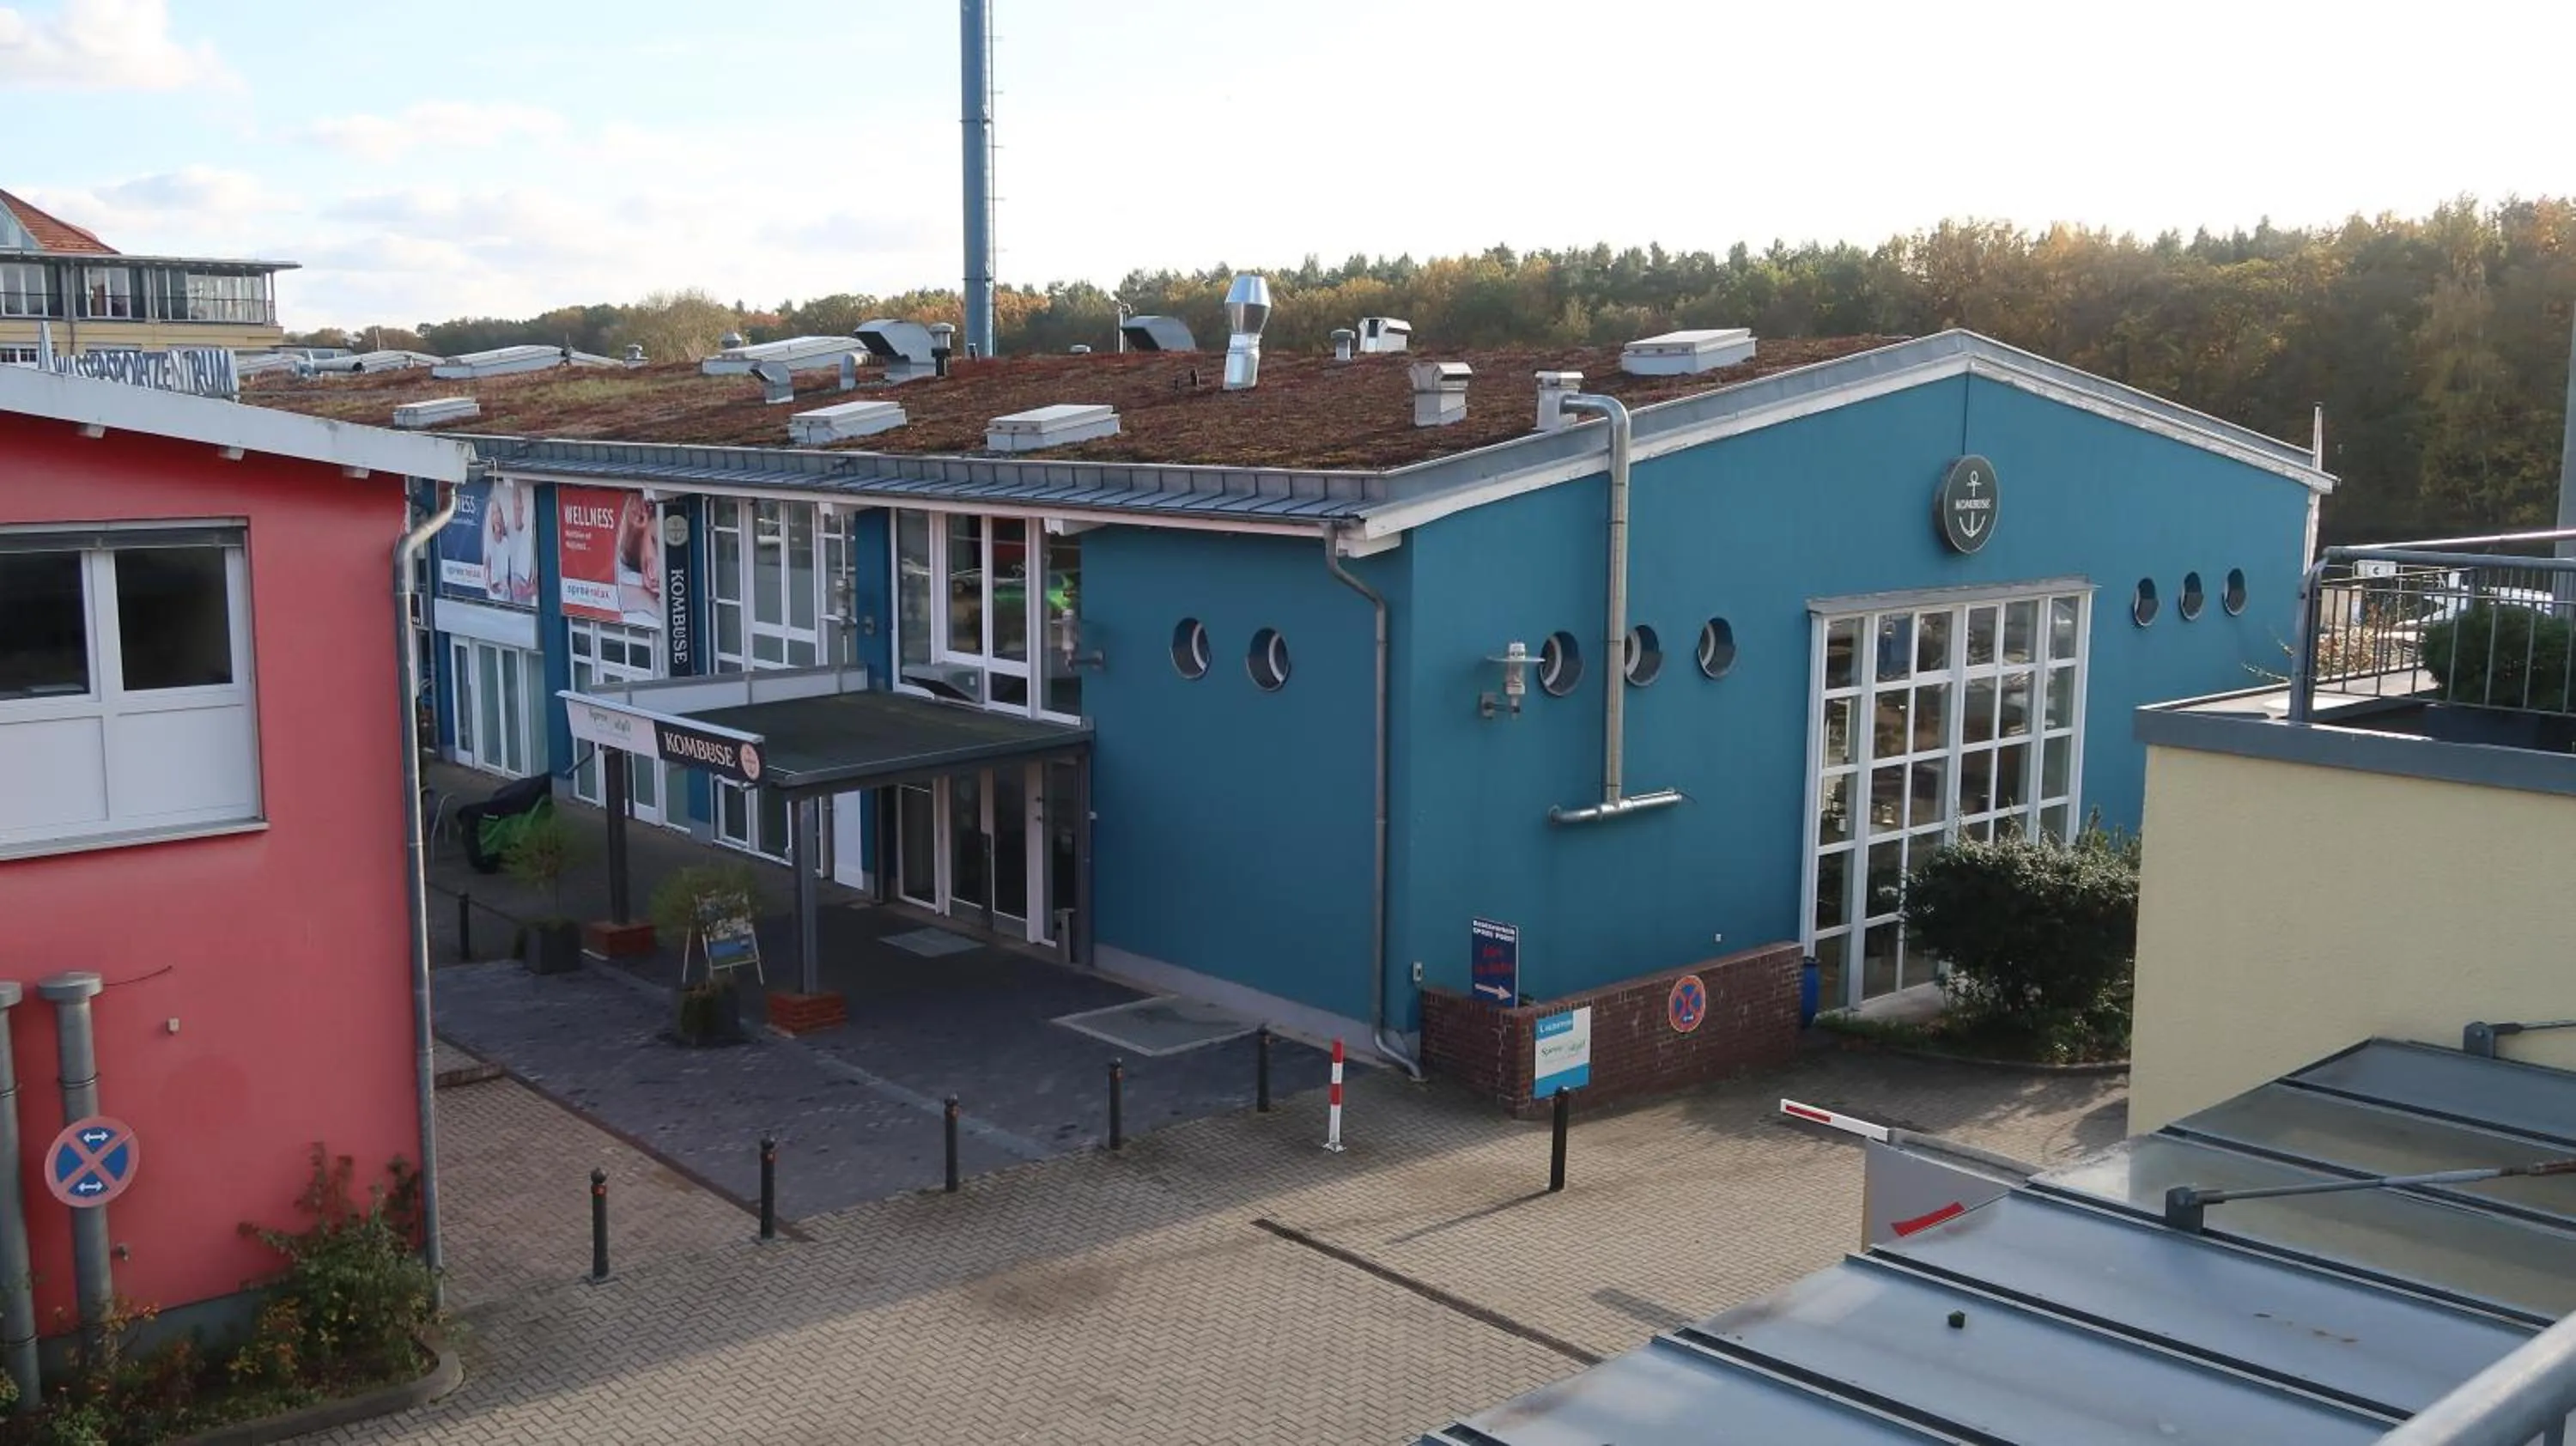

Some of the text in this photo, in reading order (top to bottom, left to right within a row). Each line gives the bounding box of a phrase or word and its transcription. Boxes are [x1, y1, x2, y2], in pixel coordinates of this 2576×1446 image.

[564, 504, 614, 529] WELLNESS
[670, 568, 688, 665] KOMBUSE
[664, 732, 738, 768] KOMBUSE
